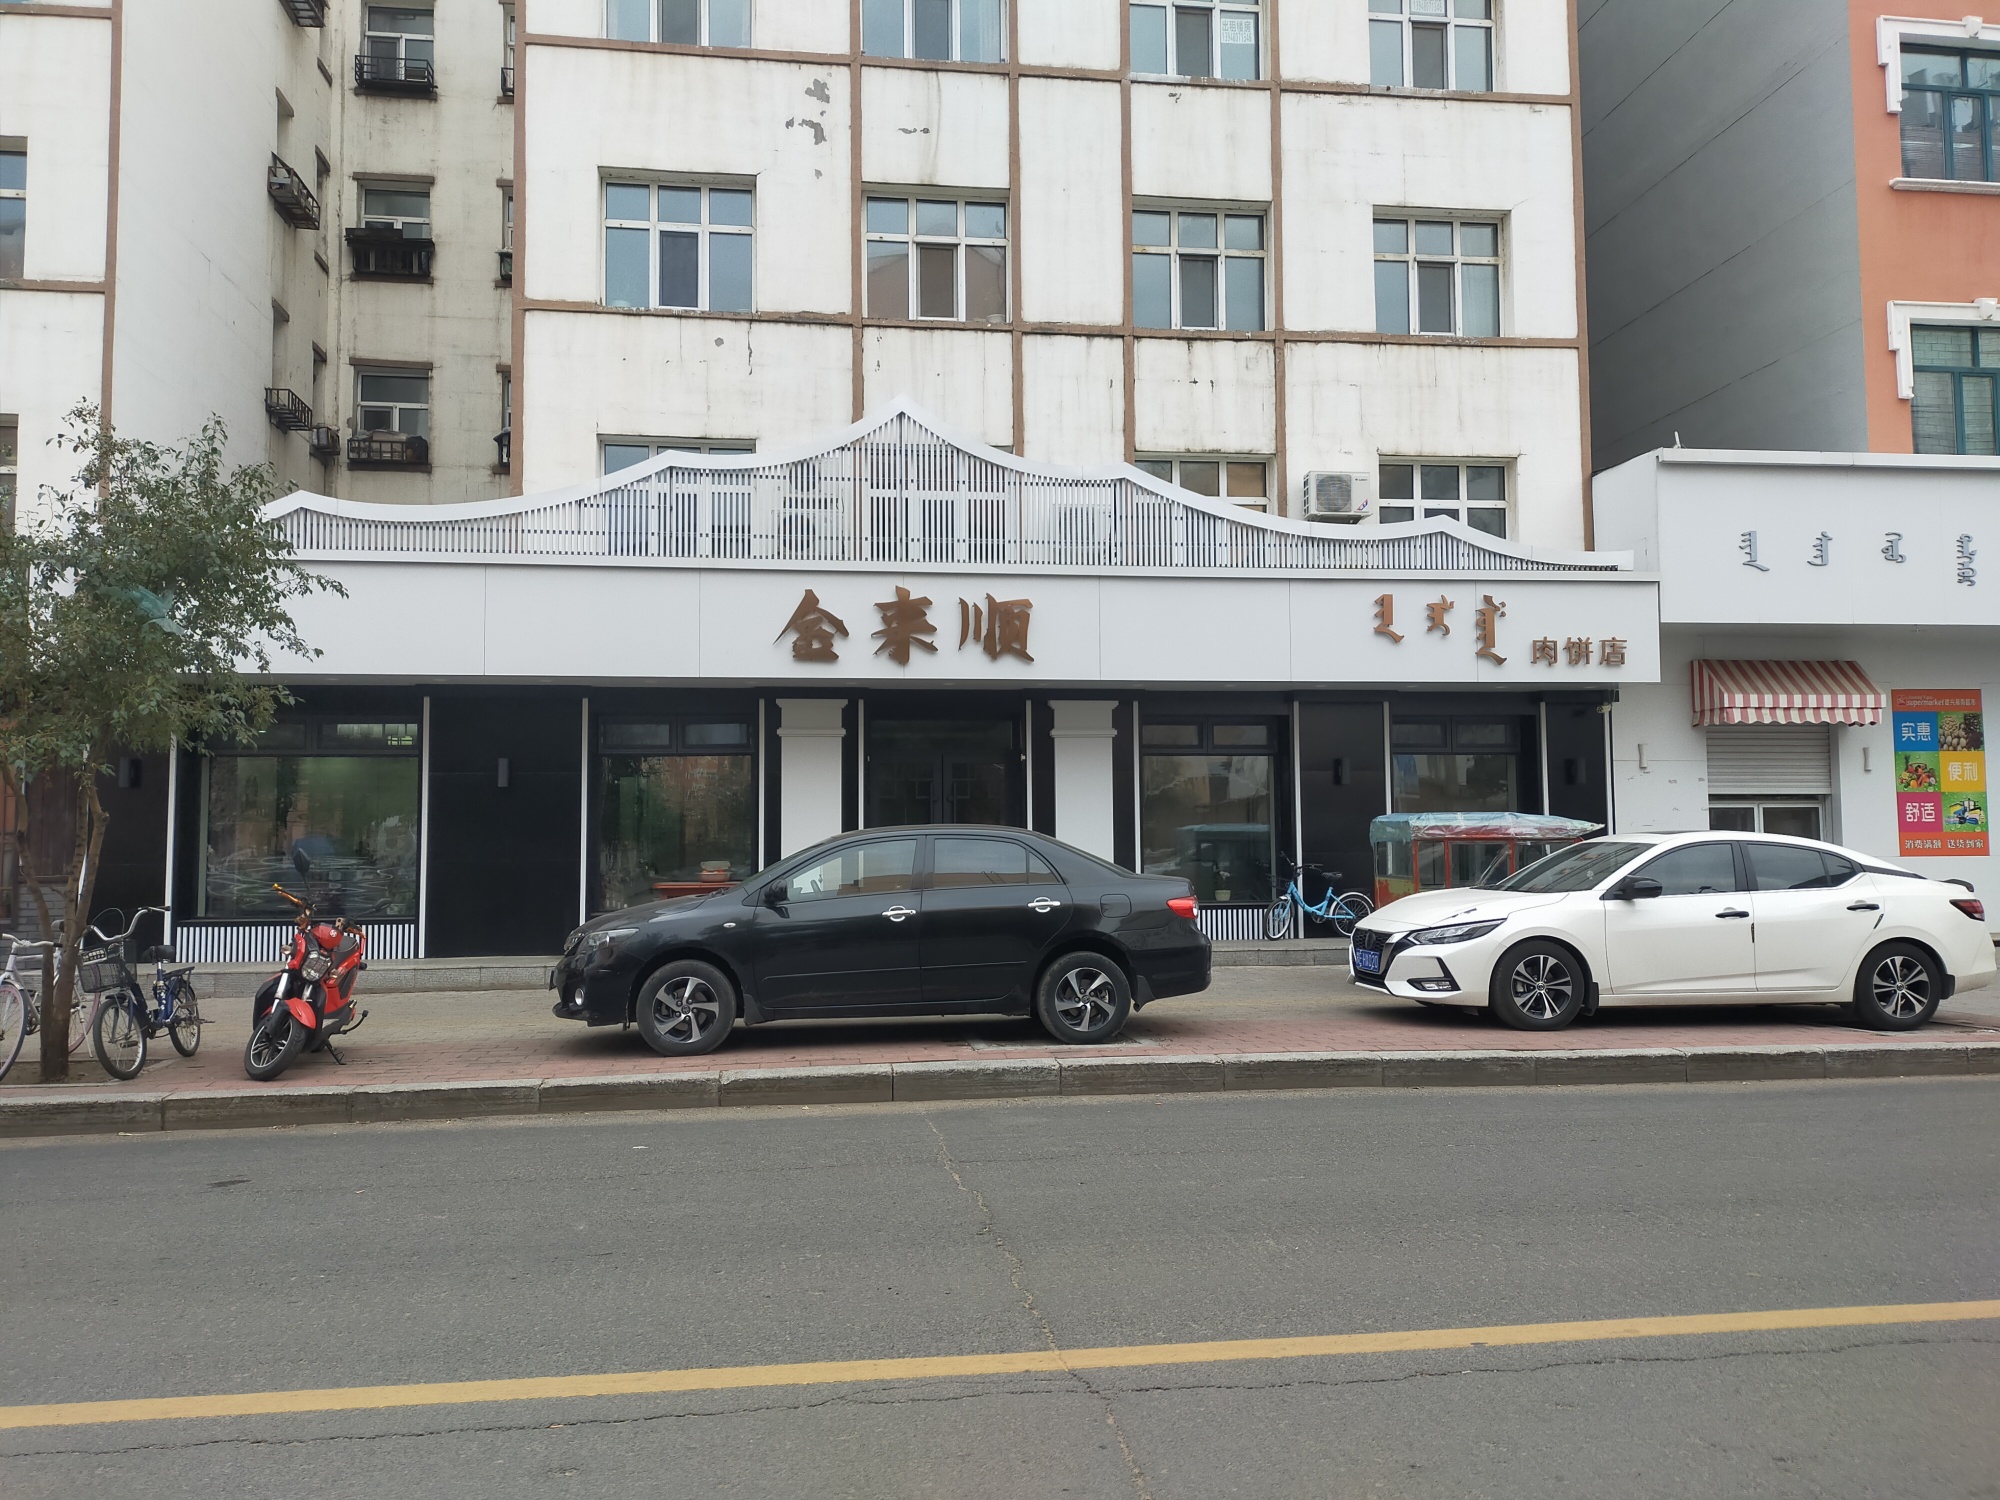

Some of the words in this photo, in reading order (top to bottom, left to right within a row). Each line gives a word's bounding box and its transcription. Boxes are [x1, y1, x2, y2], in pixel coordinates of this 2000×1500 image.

[773, 585, 1035, 665] 金来顺
[1531, 636, 1628, 666] 肉饼店
[1901, 722, 1932, 742] 实惠
[1948, 762, 1978, 782] 便利
[1905, 802, 1936, 822] 舒适
